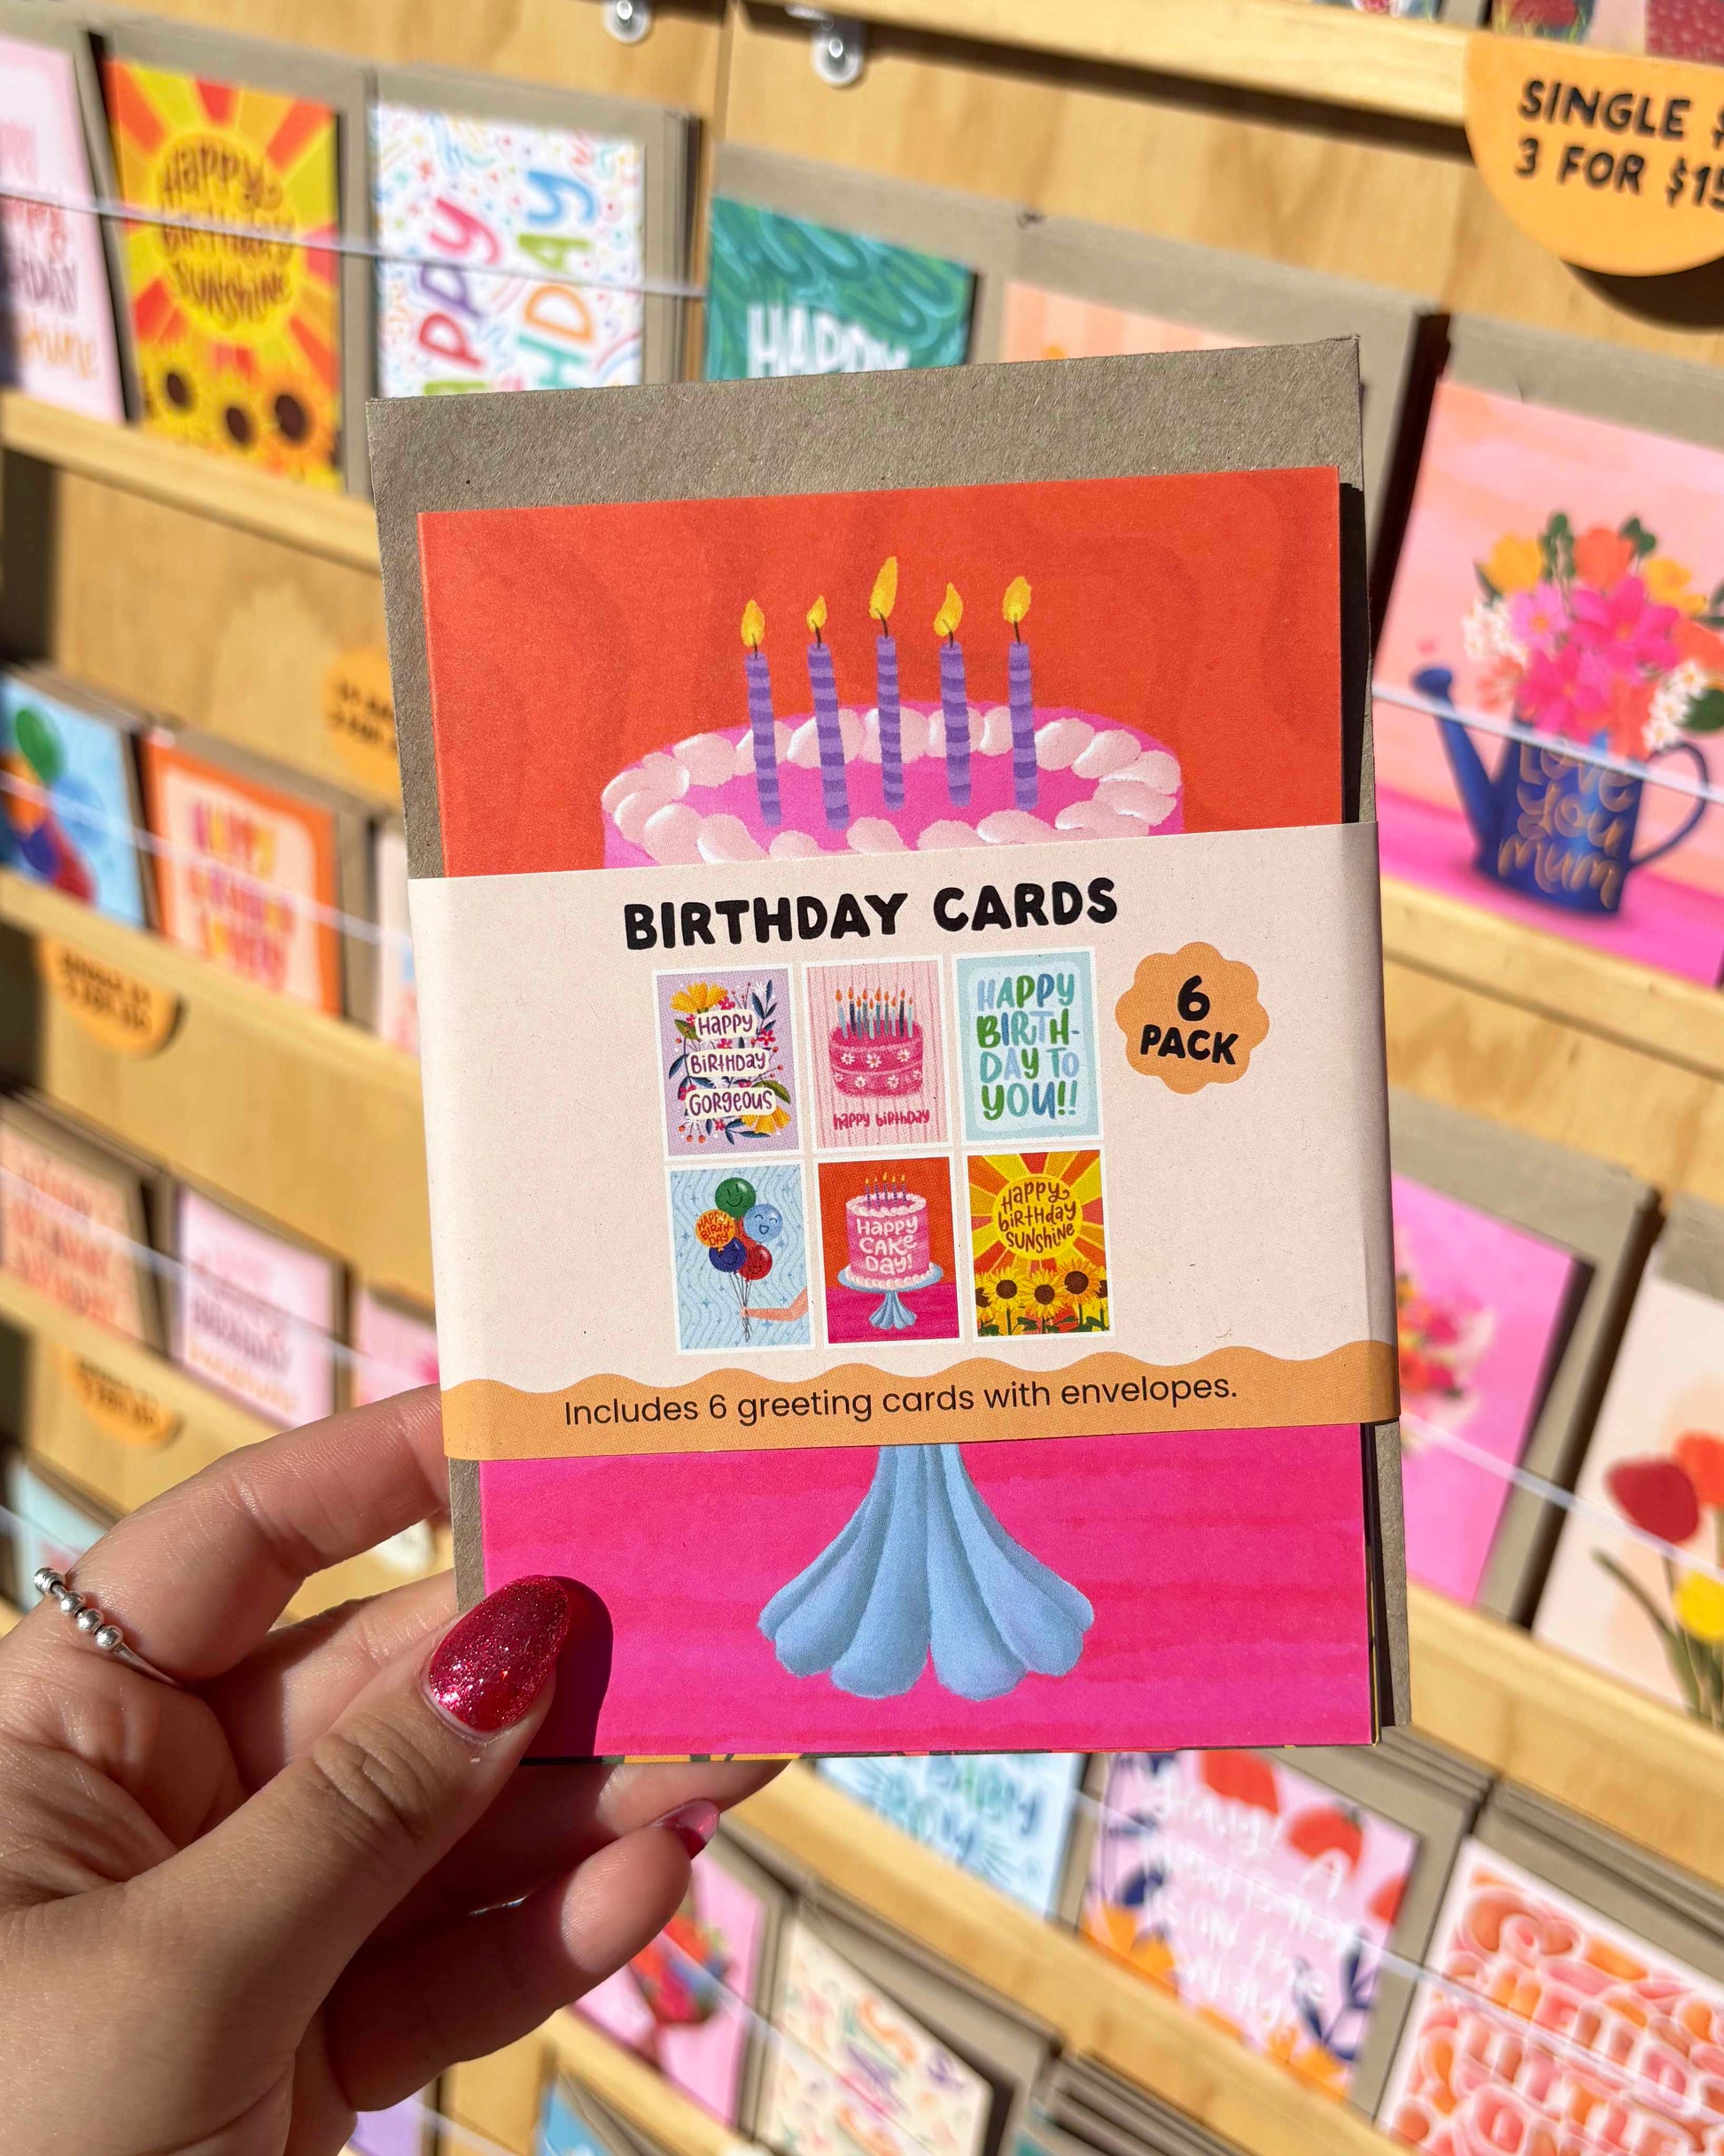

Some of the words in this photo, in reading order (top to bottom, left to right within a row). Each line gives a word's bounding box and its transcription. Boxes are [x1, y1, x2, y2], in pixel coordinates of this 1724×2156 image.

[1517, 79, 1691, 141] SINGLE
[1513, 136, 1540, 181] 3
[1556, 144, 1645, 198] FOR
[624, 892, 908, 950] BIRTHDAY
[933, 877, 1117, 931] CARDS
[977, 973, 1075, 1011] HAPPY
[1177, 975, 1210, 1021] 6
[976, 1008, 1080, 1048] BIRTH-
[1140, 1024, 1239, 1065] PACK
[980, 1047, 1039, 1084] DAY
[1045, 1047, 1080, 1078] TO
[981, 1079, 1078, 1121] YOU!!
[565, 1396, 699, 1425] Includes
[709, 1394, 727, 1420] 6
[737, 1389, 873, 1427] greeting
[882, 1384, 975, 1413] cards
[983, 1381, 1051, 1409] with
[1061, 1375, 1238, 1409] envelopes.
